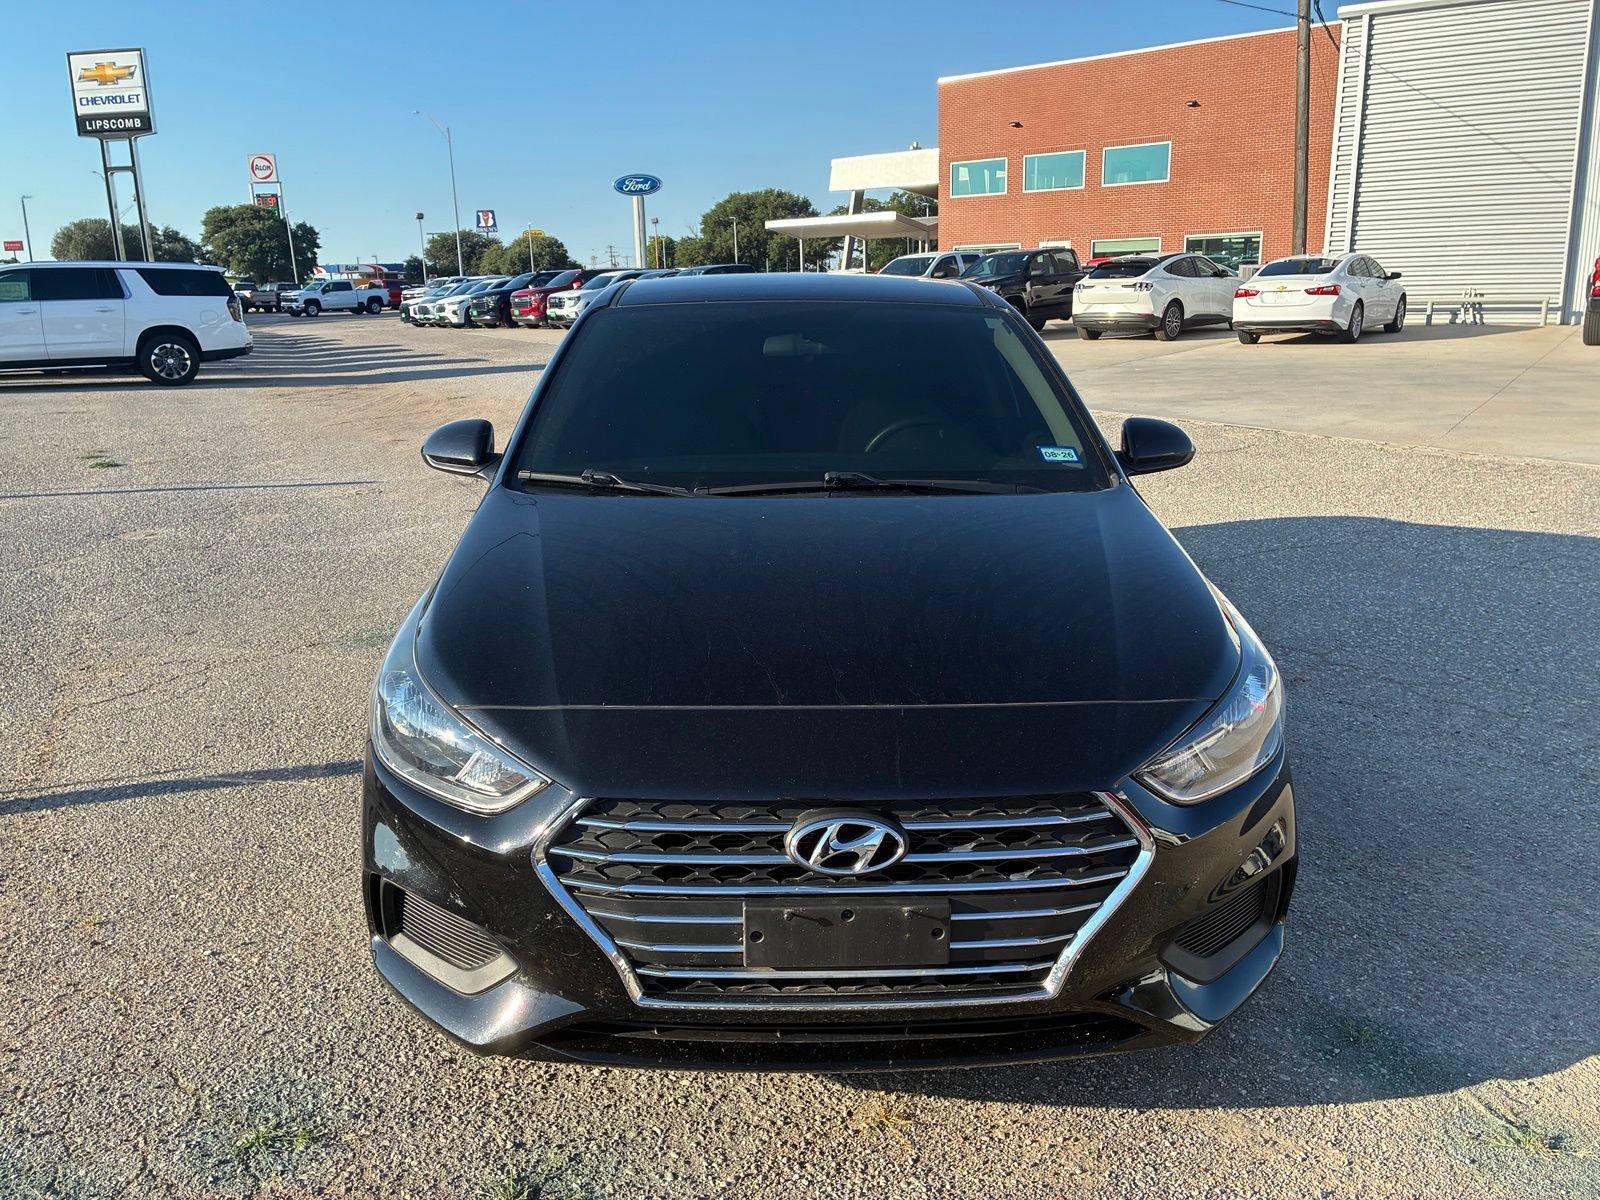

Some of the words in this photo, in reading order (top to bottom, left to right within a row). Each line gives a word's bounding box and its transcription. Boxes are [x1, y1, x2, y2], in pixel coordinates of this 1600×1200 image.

[79, 94, 141, 107] CHEVROLET
[86, 118, 142, 130] LIPSCOMB
[622, 177, 651, 192] Ford
